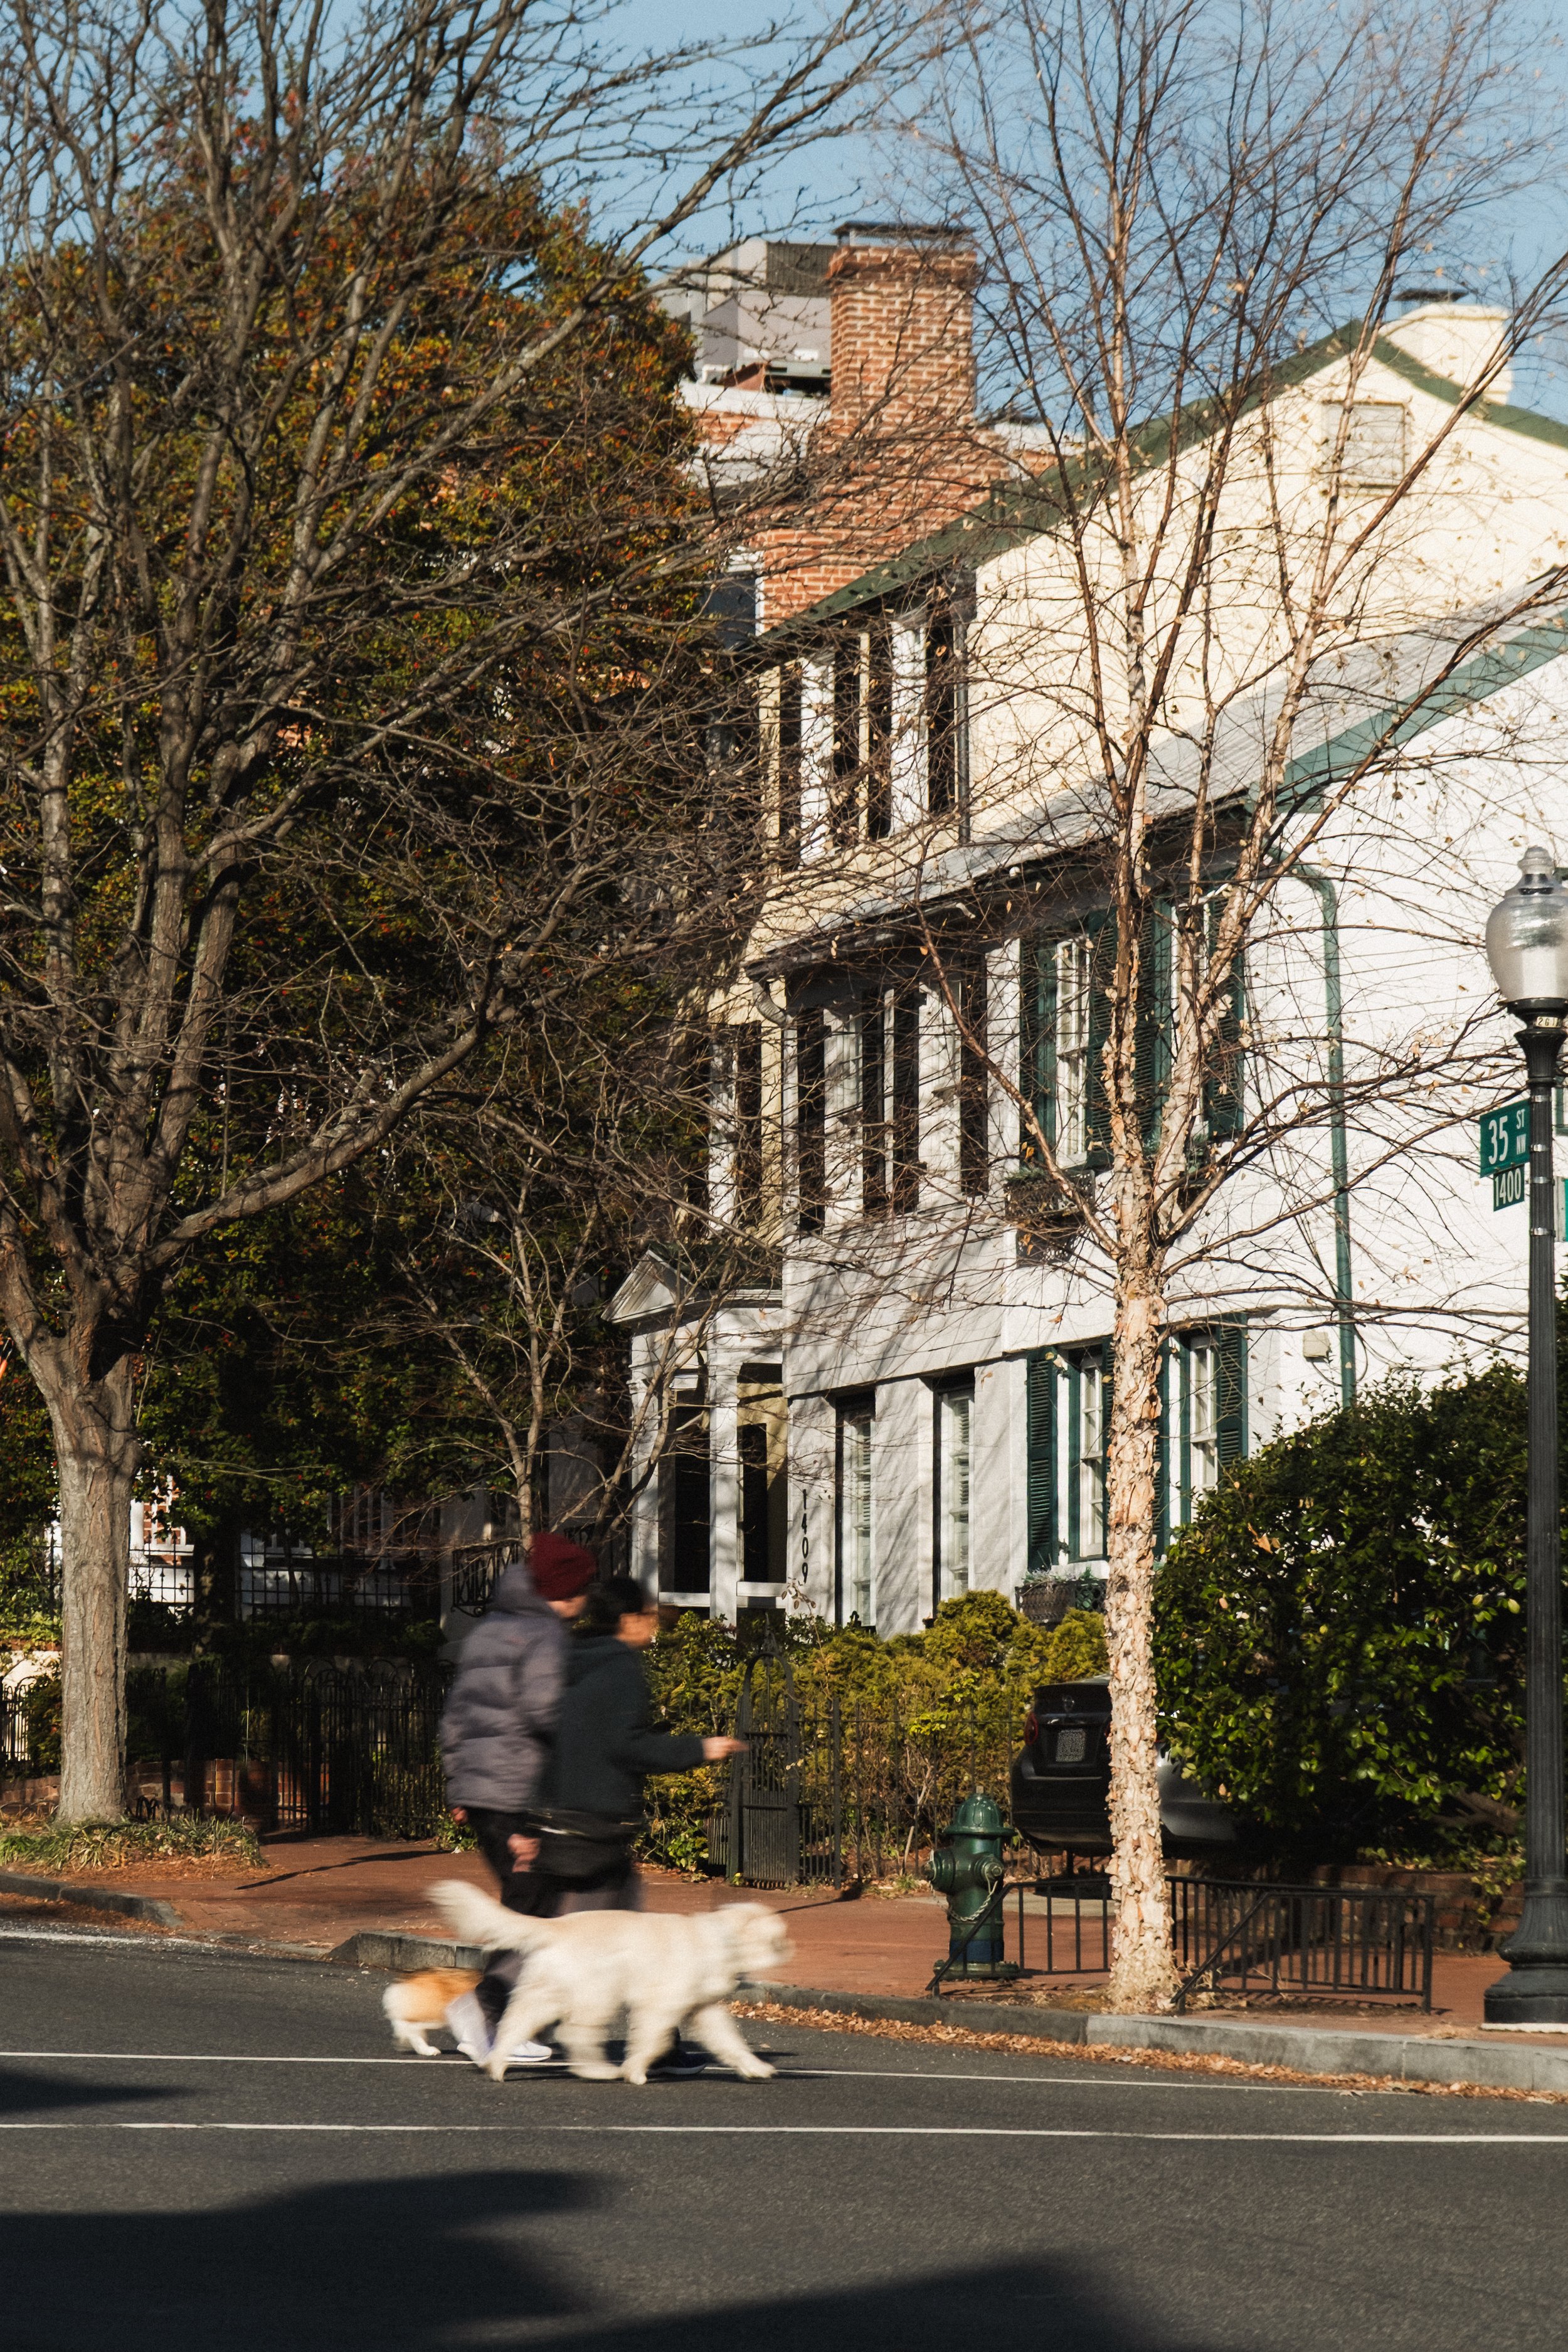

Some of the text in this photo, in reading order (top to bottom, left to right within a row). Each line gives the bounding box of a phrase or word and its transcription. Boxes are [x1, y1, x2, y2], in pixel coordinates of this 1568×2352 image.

[1488, 1108, 1525, 1165] 35 ST
[1516, 1133, 1526, 1155] NW
[1495, 1168, 1522, 1207] 1400
